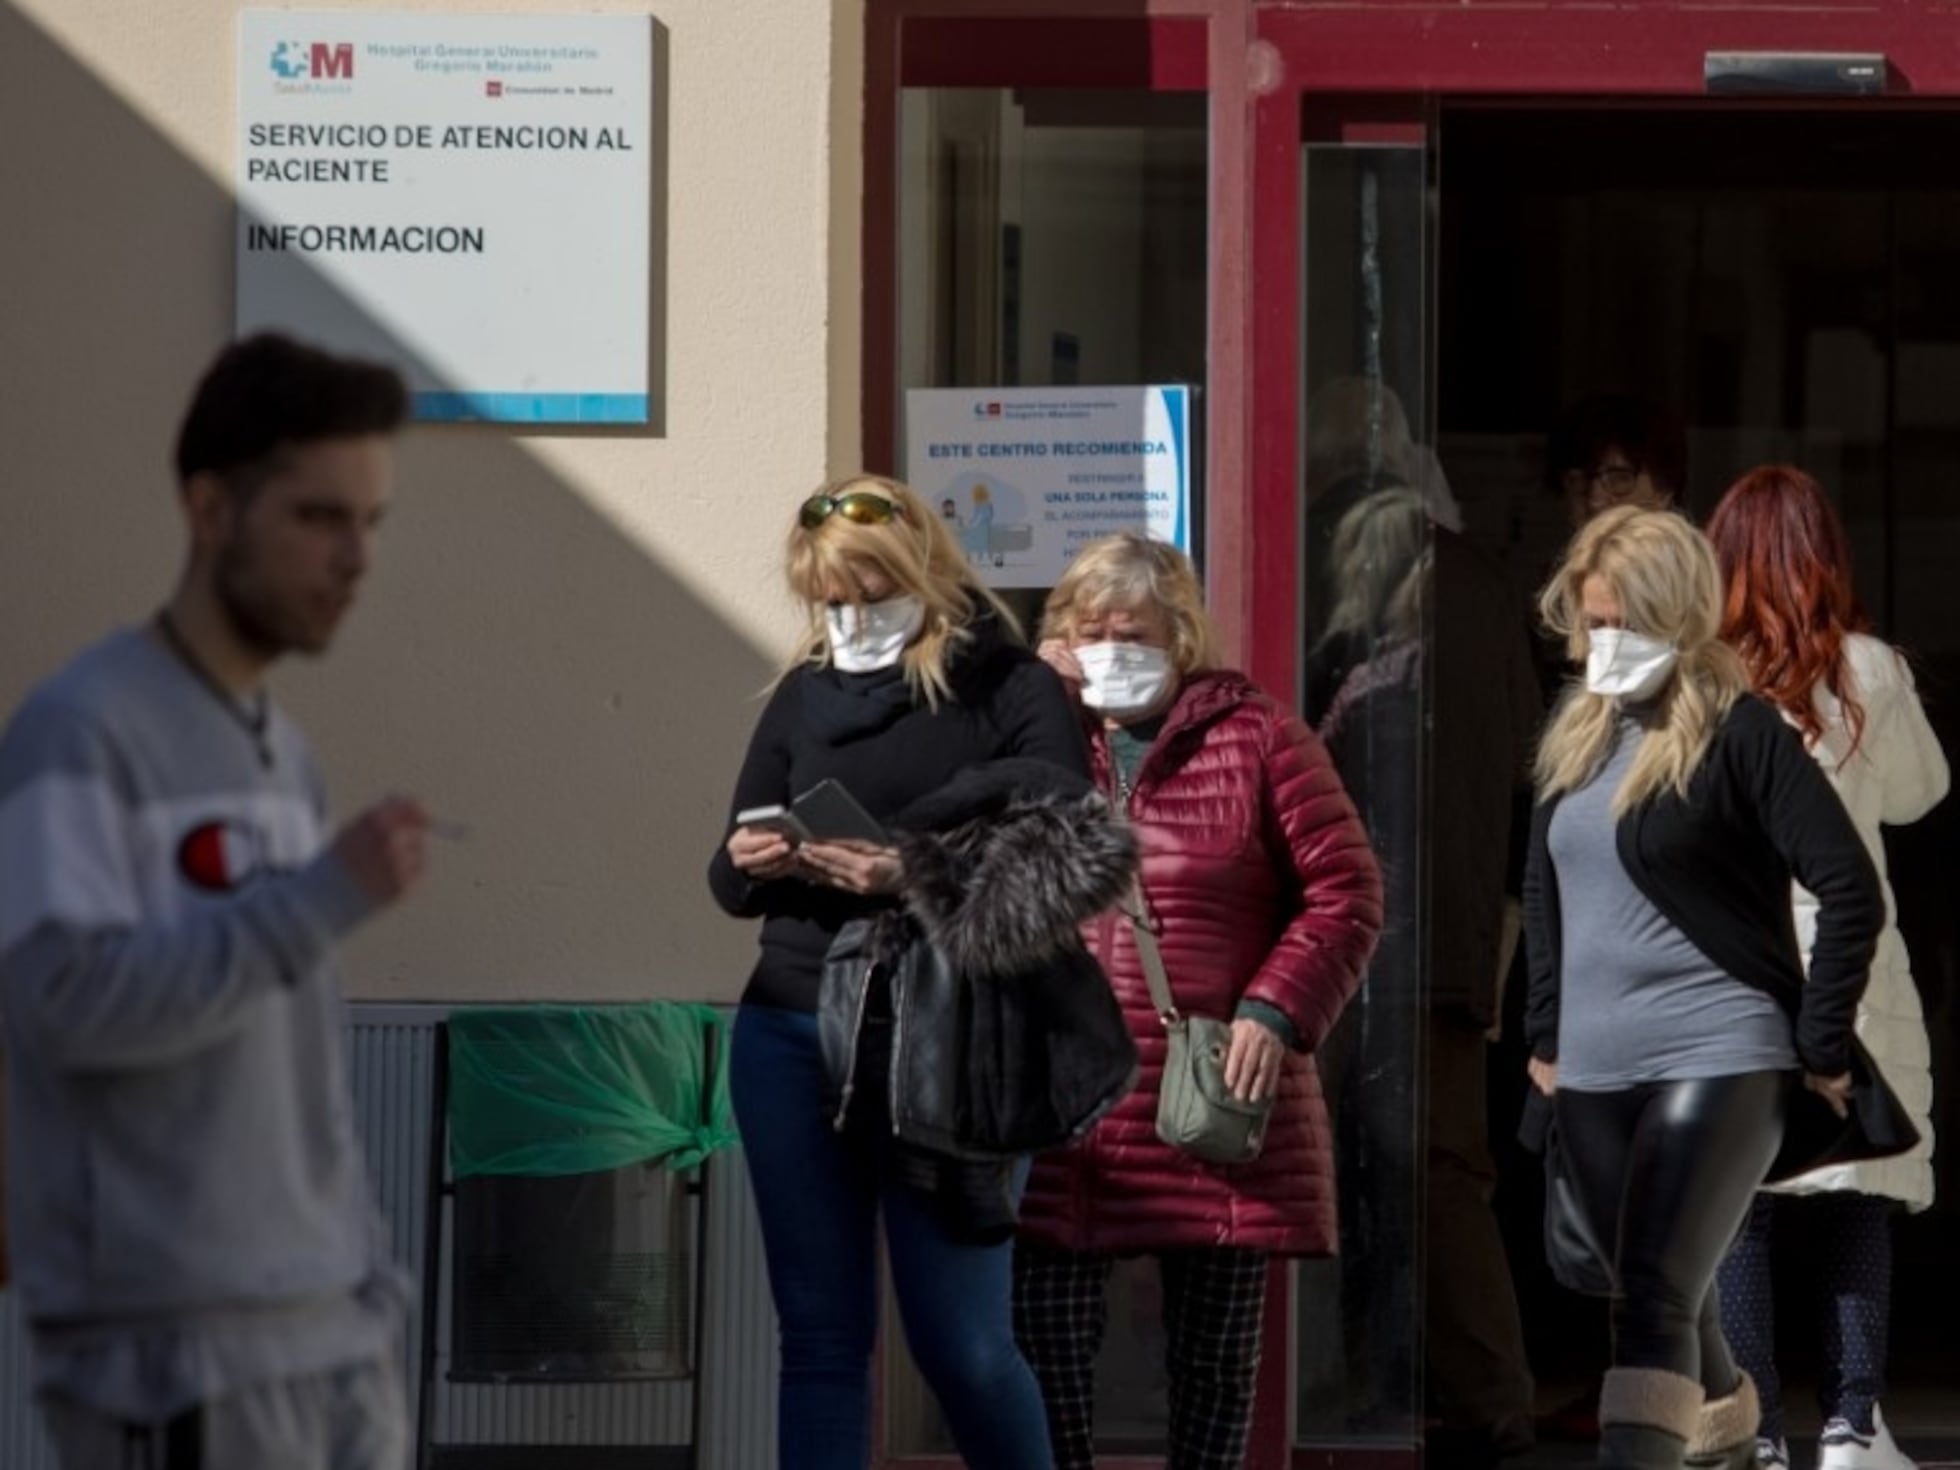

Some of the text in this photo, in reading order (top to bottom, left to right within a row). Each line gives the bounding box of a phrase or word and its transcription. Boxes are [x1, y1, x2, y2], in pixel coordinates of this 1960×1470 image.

[249, 124, 632, 151] SERVICIO DE ATENCION AL
[248, 160, 389, 183] PACIENTE
[247, 226, 484, 254] INFORMACION
[928, 441, 1168, 458] ESTE CENTRO RECOMIENDA
